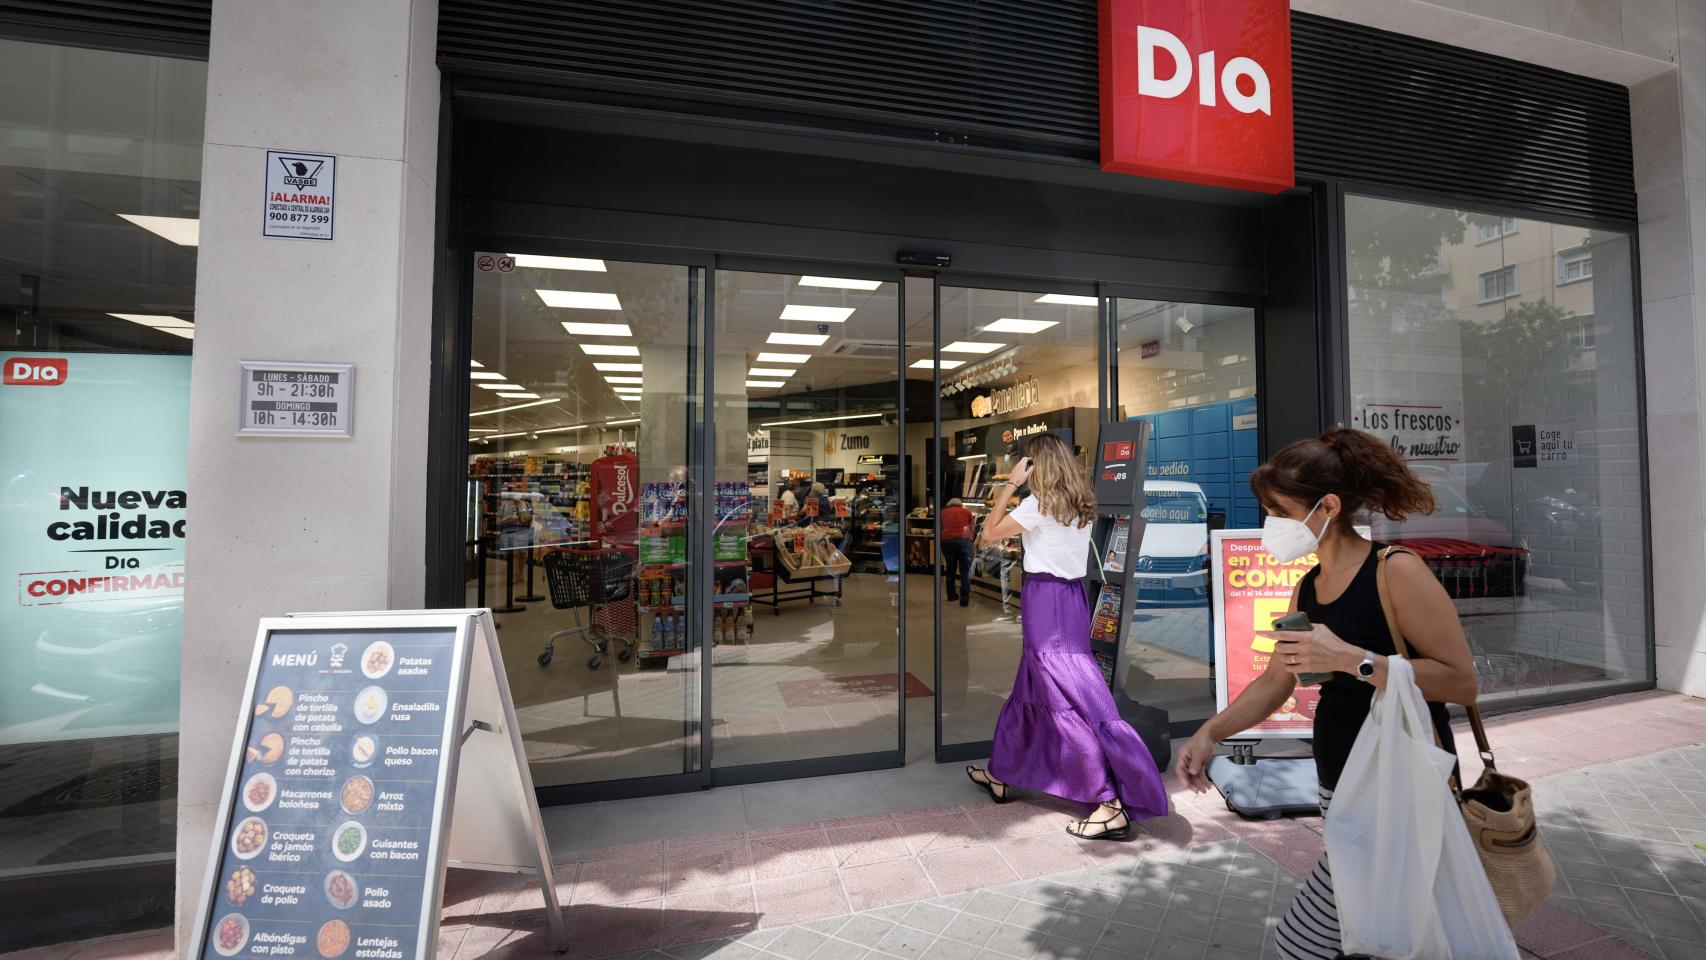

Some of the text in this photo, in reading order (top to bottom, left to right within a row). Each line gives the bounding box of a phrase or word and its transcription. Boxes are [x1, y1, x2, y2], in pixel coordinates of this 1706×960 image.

[1137, 25, 1271, 117] Dia
[286, 177, 315, 185] VASBE
[270, 192, 330, 205] ¡ALARMA!
[269, 212, 329, 224] 900 877 599
[13, 363, 58, 380] Dia
[263, 373, 288, 382] LUNES
[297, 373, 330, 383] SÁBADO
[257, 383, 274, 396] 9h
[291, 383, 334, 398] 21:30h
[991, 375, 1040, 416] Panadería
[276, 402, 311, 411] DOMINGO
[254, 411, 275, 425] 10h
[292, 411, 336, 426] 14:30h
[1363, 409, 1452, 431] Los frescos
[1541, 430, 1561, 441] Coge
[753, 437, 769, 451] plato
[840, 434, 869, 450] Zumo
[1410, 435, 1460, 456] nuestro
[1563, 440, 1572, 449] tu
[1541, 452, 1566, 460] carro
[1148, 465, 1157, 475] tu
[612, 465, 628, 515] Dulcesol
[60, 486, 187, 510] Nueva
[105, 556, 140, 569] Dia
[1228, 553, 1320, 567] en TOAS
[1229, 568, 1306, 588] COMP
[272, 651, 317, 667] MENÚ
[399, 657, 432, 667] Patatas
[398, 667, 428, 676] asadas
[299, 694, 328, 702] Pincho
[297, 704, 338, 712] de tortilla
[392, 703, 440, 712] Ensaladilla
[295, 714, 336, 723] de patata
[310, 723, 342, 732] cebolla
[291, 738, 321, 746] Pincho
[289, 748, 330, 756] de tortilla
[386, 747, 438, 755] Pollo bacon
[287, 757, 328, 767] de patata
[384, 758, 412, 767] queso
[285, 767, 336, 776] con chorizo
[280, 790, 333, 799] Macarrones
[379, 792, 404, 800] Arroz
[278, 799, 319, 809] boloñesa
[377, 802, 404, 811] mixto
[273, 832, 315, 842] Croqueta
[271, 842, 313, 853] de jamón
[372, 840, 418, 849] Guisantes
[269, 852, 300, 861] ibérico
[370, 851, 419, 860] con bacon
[263, 884, 305, 895] Croqueta
[364, 888, 389, 897] Pollo
[261, 895, 298, 906] de pollo
[363, 899, 391, 908] asado
[253, 933, 307, 945] Albóndigas
[357, 937, 398, 948] Lentejas
[251, 945, 294, 956] con pisto
[355, 948, 402, 959] estofadas
